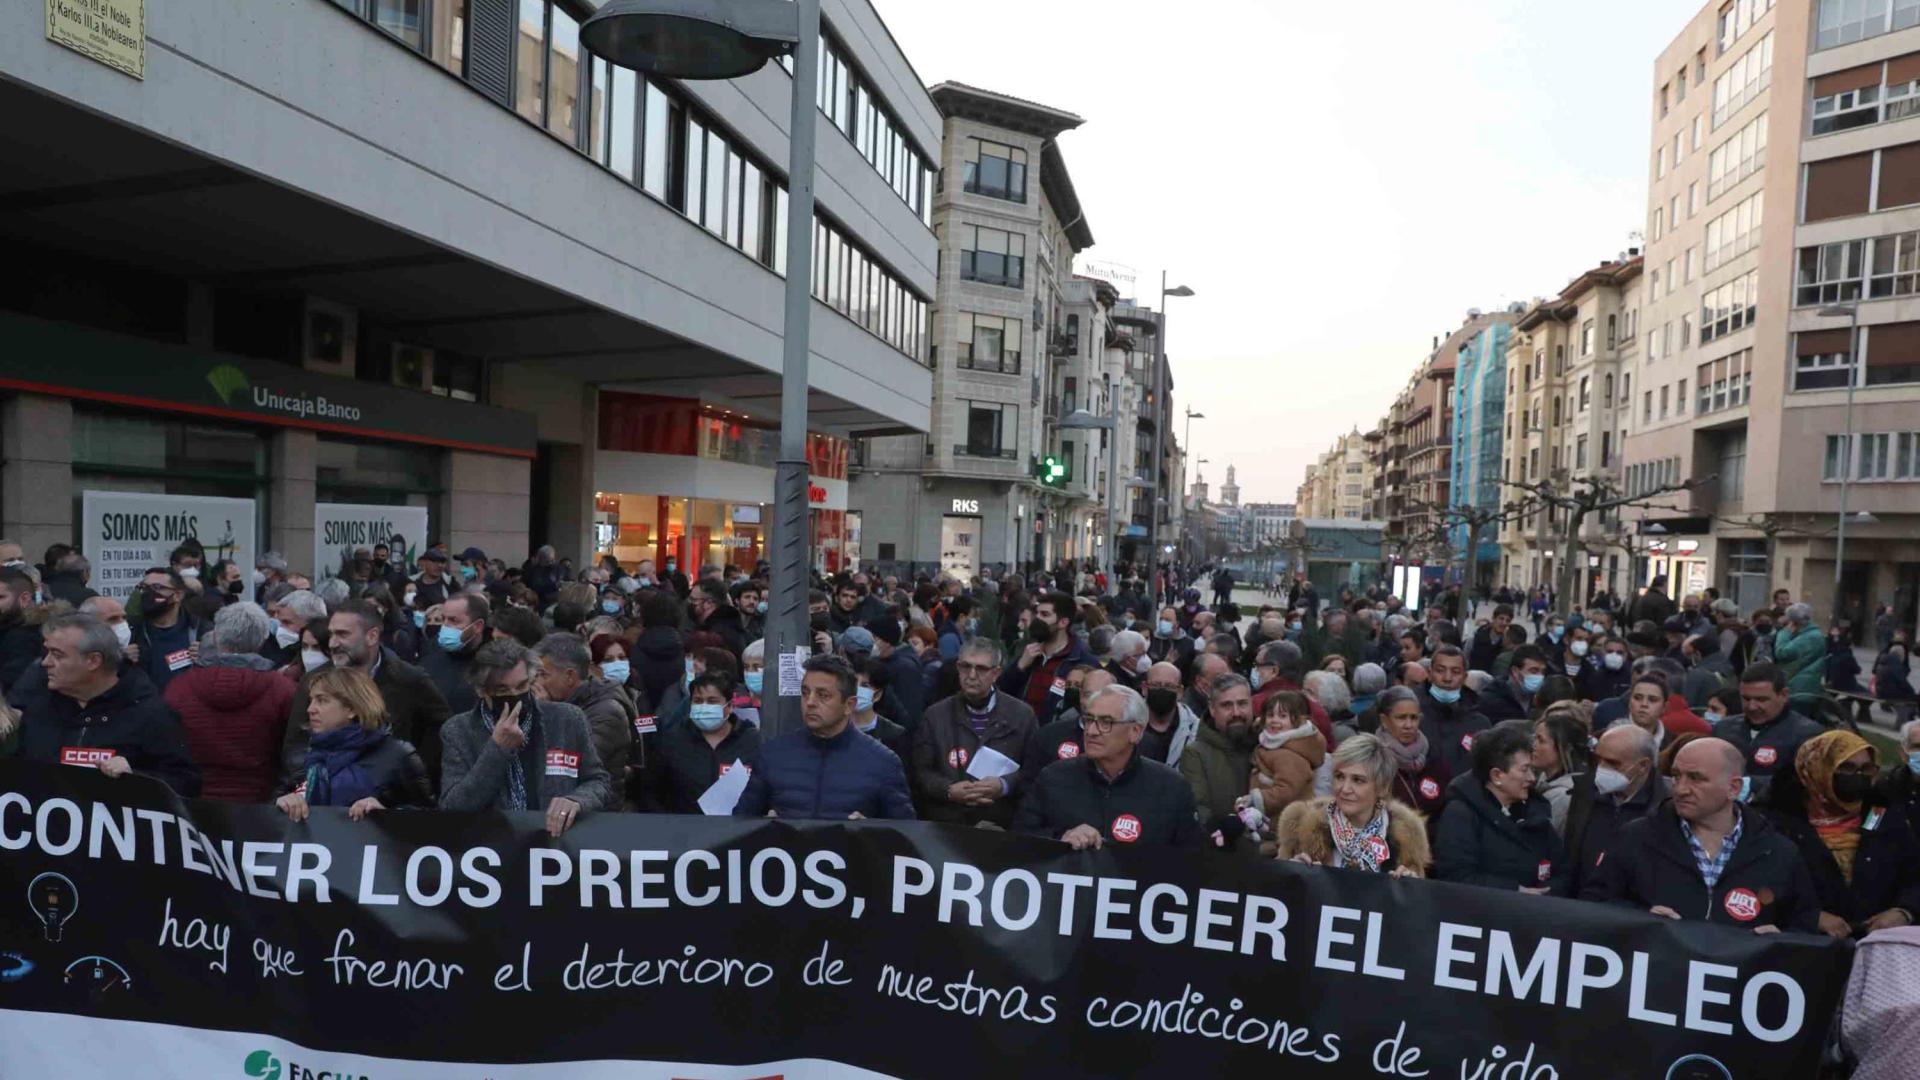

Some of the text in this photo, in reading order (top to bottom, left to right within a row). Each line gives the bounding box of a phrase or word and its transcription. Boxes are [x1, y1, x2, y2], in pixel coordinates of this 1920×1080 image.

[57, 1, 82, 25] Karlos
[101, 21, 138, 51] Noblearen
[101, 1, 108, 16] el
[110, 6, 132, 29] Noble
[253, 386, 361, 421] Unicaja Banco
[952, 498, 979, 513] RKS
[102, 509, 198, 542] SOMOS MÁS
[324, 520, 366, 546] SOMOS
[102, 550, 110, 561] EN
[113, 550, 121, 561] TU
[102, 568, 110, 579] EN
[113, 568, 121, 579] TU
[102, 586, 110, 597] EN
[1729, 890, 1758, 910] UGT
[0, 792, 1805, 1042] CONTENER LOS PRECIOS, PROTEGER EL EMPLEO
[158, 897, 231, 973] hay
[253, 938, 304, 978] que
[324, 927, 465, 990] frenar
[494, 941, 532, 992] el
[563, 942, 774, 990] deterioro
[803, 940, 852, 986] de
[877, 964, 1057, 1024] nuestras
[1086, 982, 1341, 1063] condiciones
[1372, 1020, 1429, 1078] de
